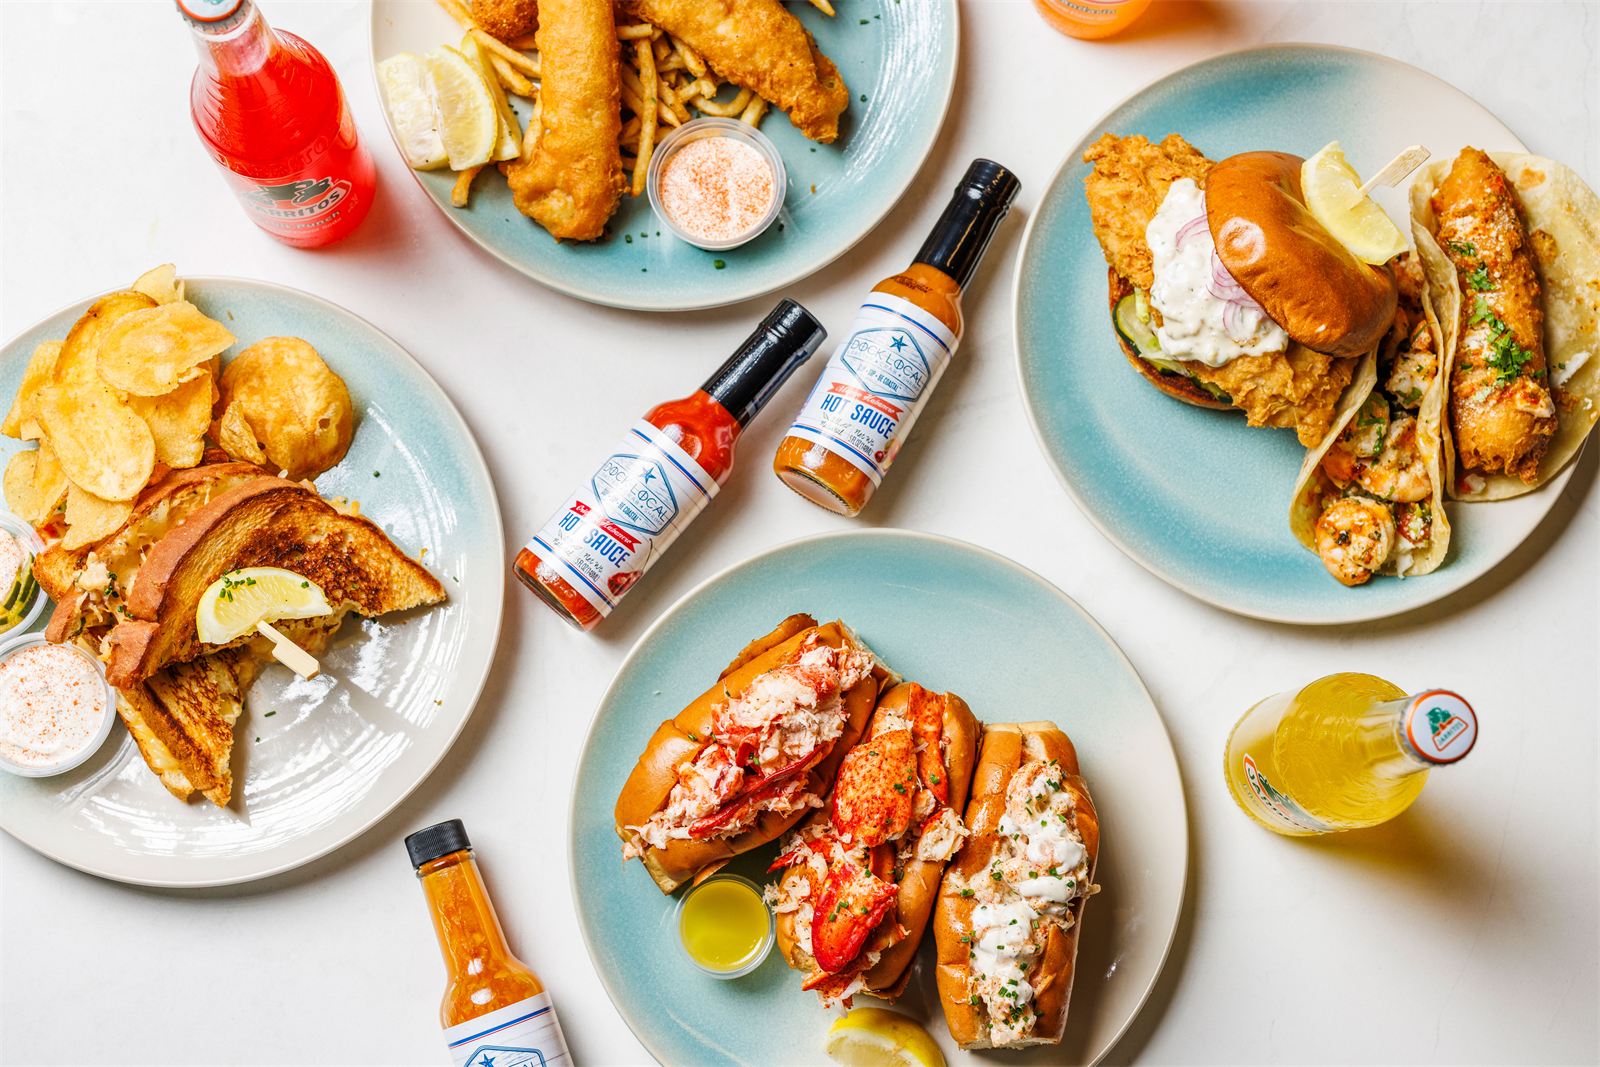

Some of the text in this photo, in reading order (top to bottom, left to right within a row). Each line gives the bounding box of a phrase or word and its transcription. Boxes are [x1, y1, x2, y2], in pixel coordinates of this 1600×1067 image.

[254, 190, 340, 217] ARRITOS
[885, 354, 921, 386] LOCAL
[820, 393, 849, 412] HOT
[851, 404, 896, 439] SAUCE
[631, 484, 665, 522] LOCAL
[558, 511, 580, 533] HO
[583, 527, 630, 568] SAUCE
